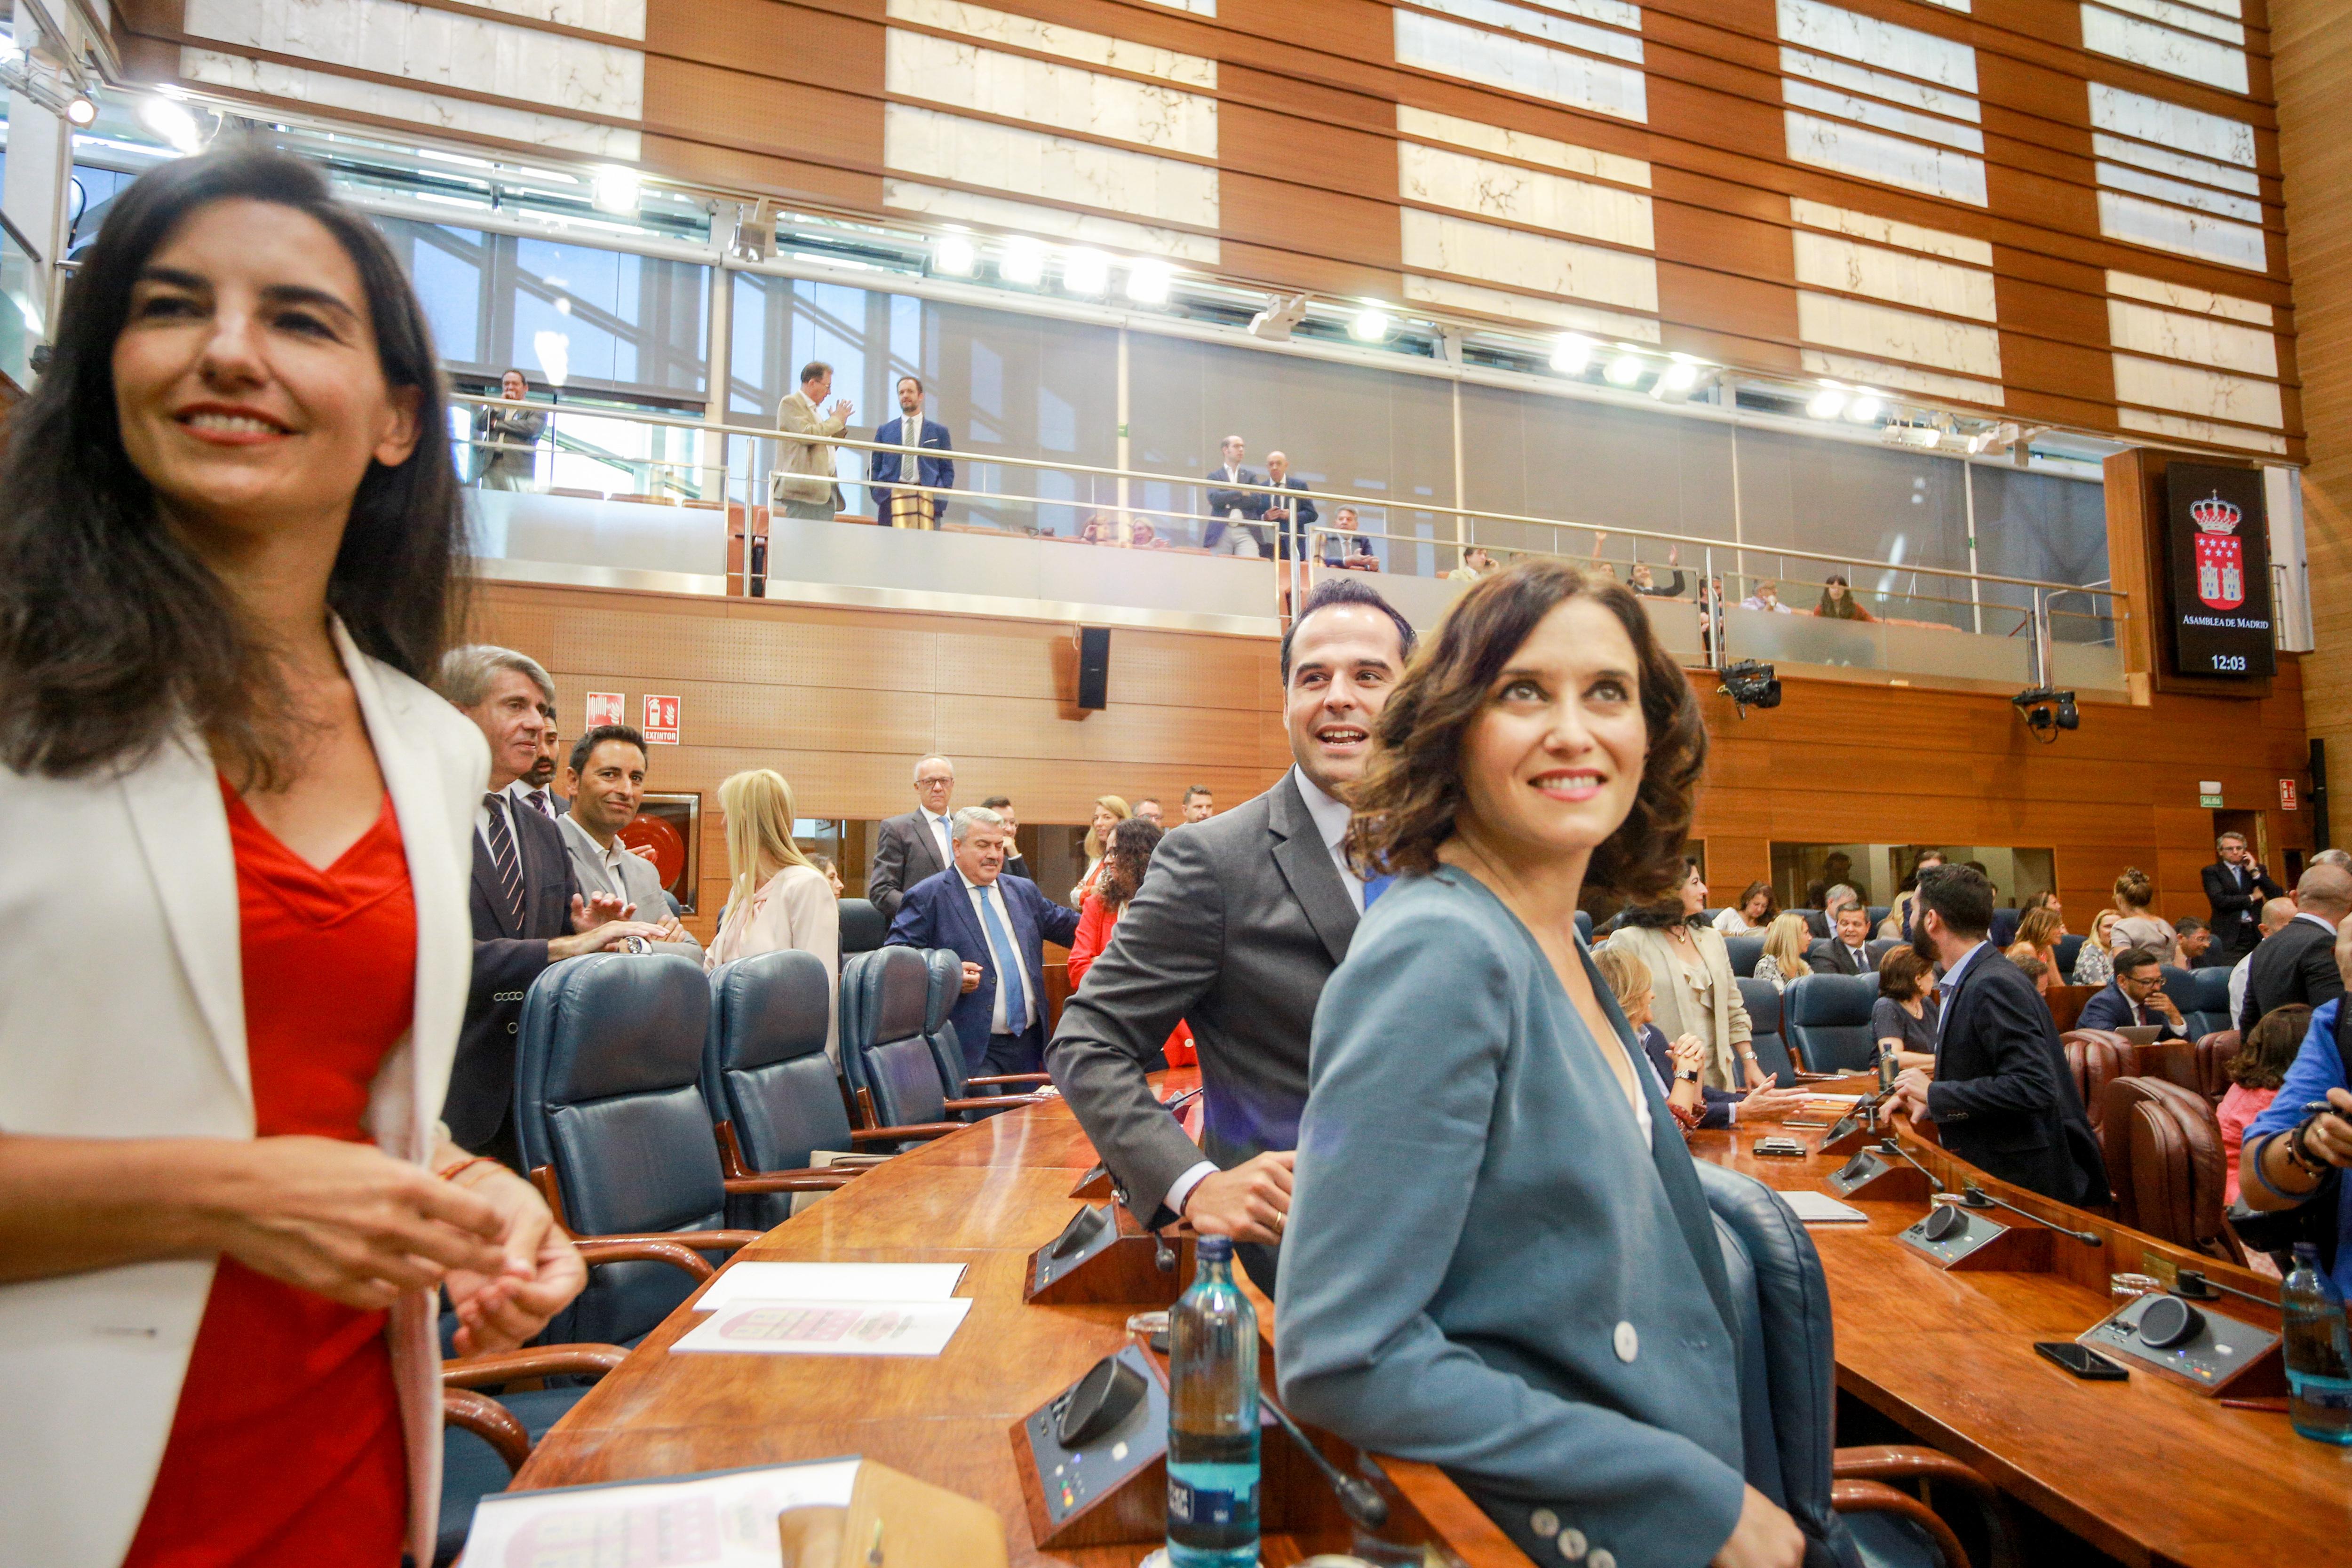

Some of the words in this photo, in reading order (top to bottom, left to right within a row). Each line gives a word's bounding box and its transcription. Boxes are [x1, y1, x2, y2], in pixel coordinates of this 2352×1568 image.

[2183, 614, 2225, 627] ASAMBLEA
[2225, 618, 2235, 627] DE
[2237, 618, 2268, 629] MADRID
[2212, 655, 2246, 670] 12:03
[646, 732, 676, 740] EXTINTOR
